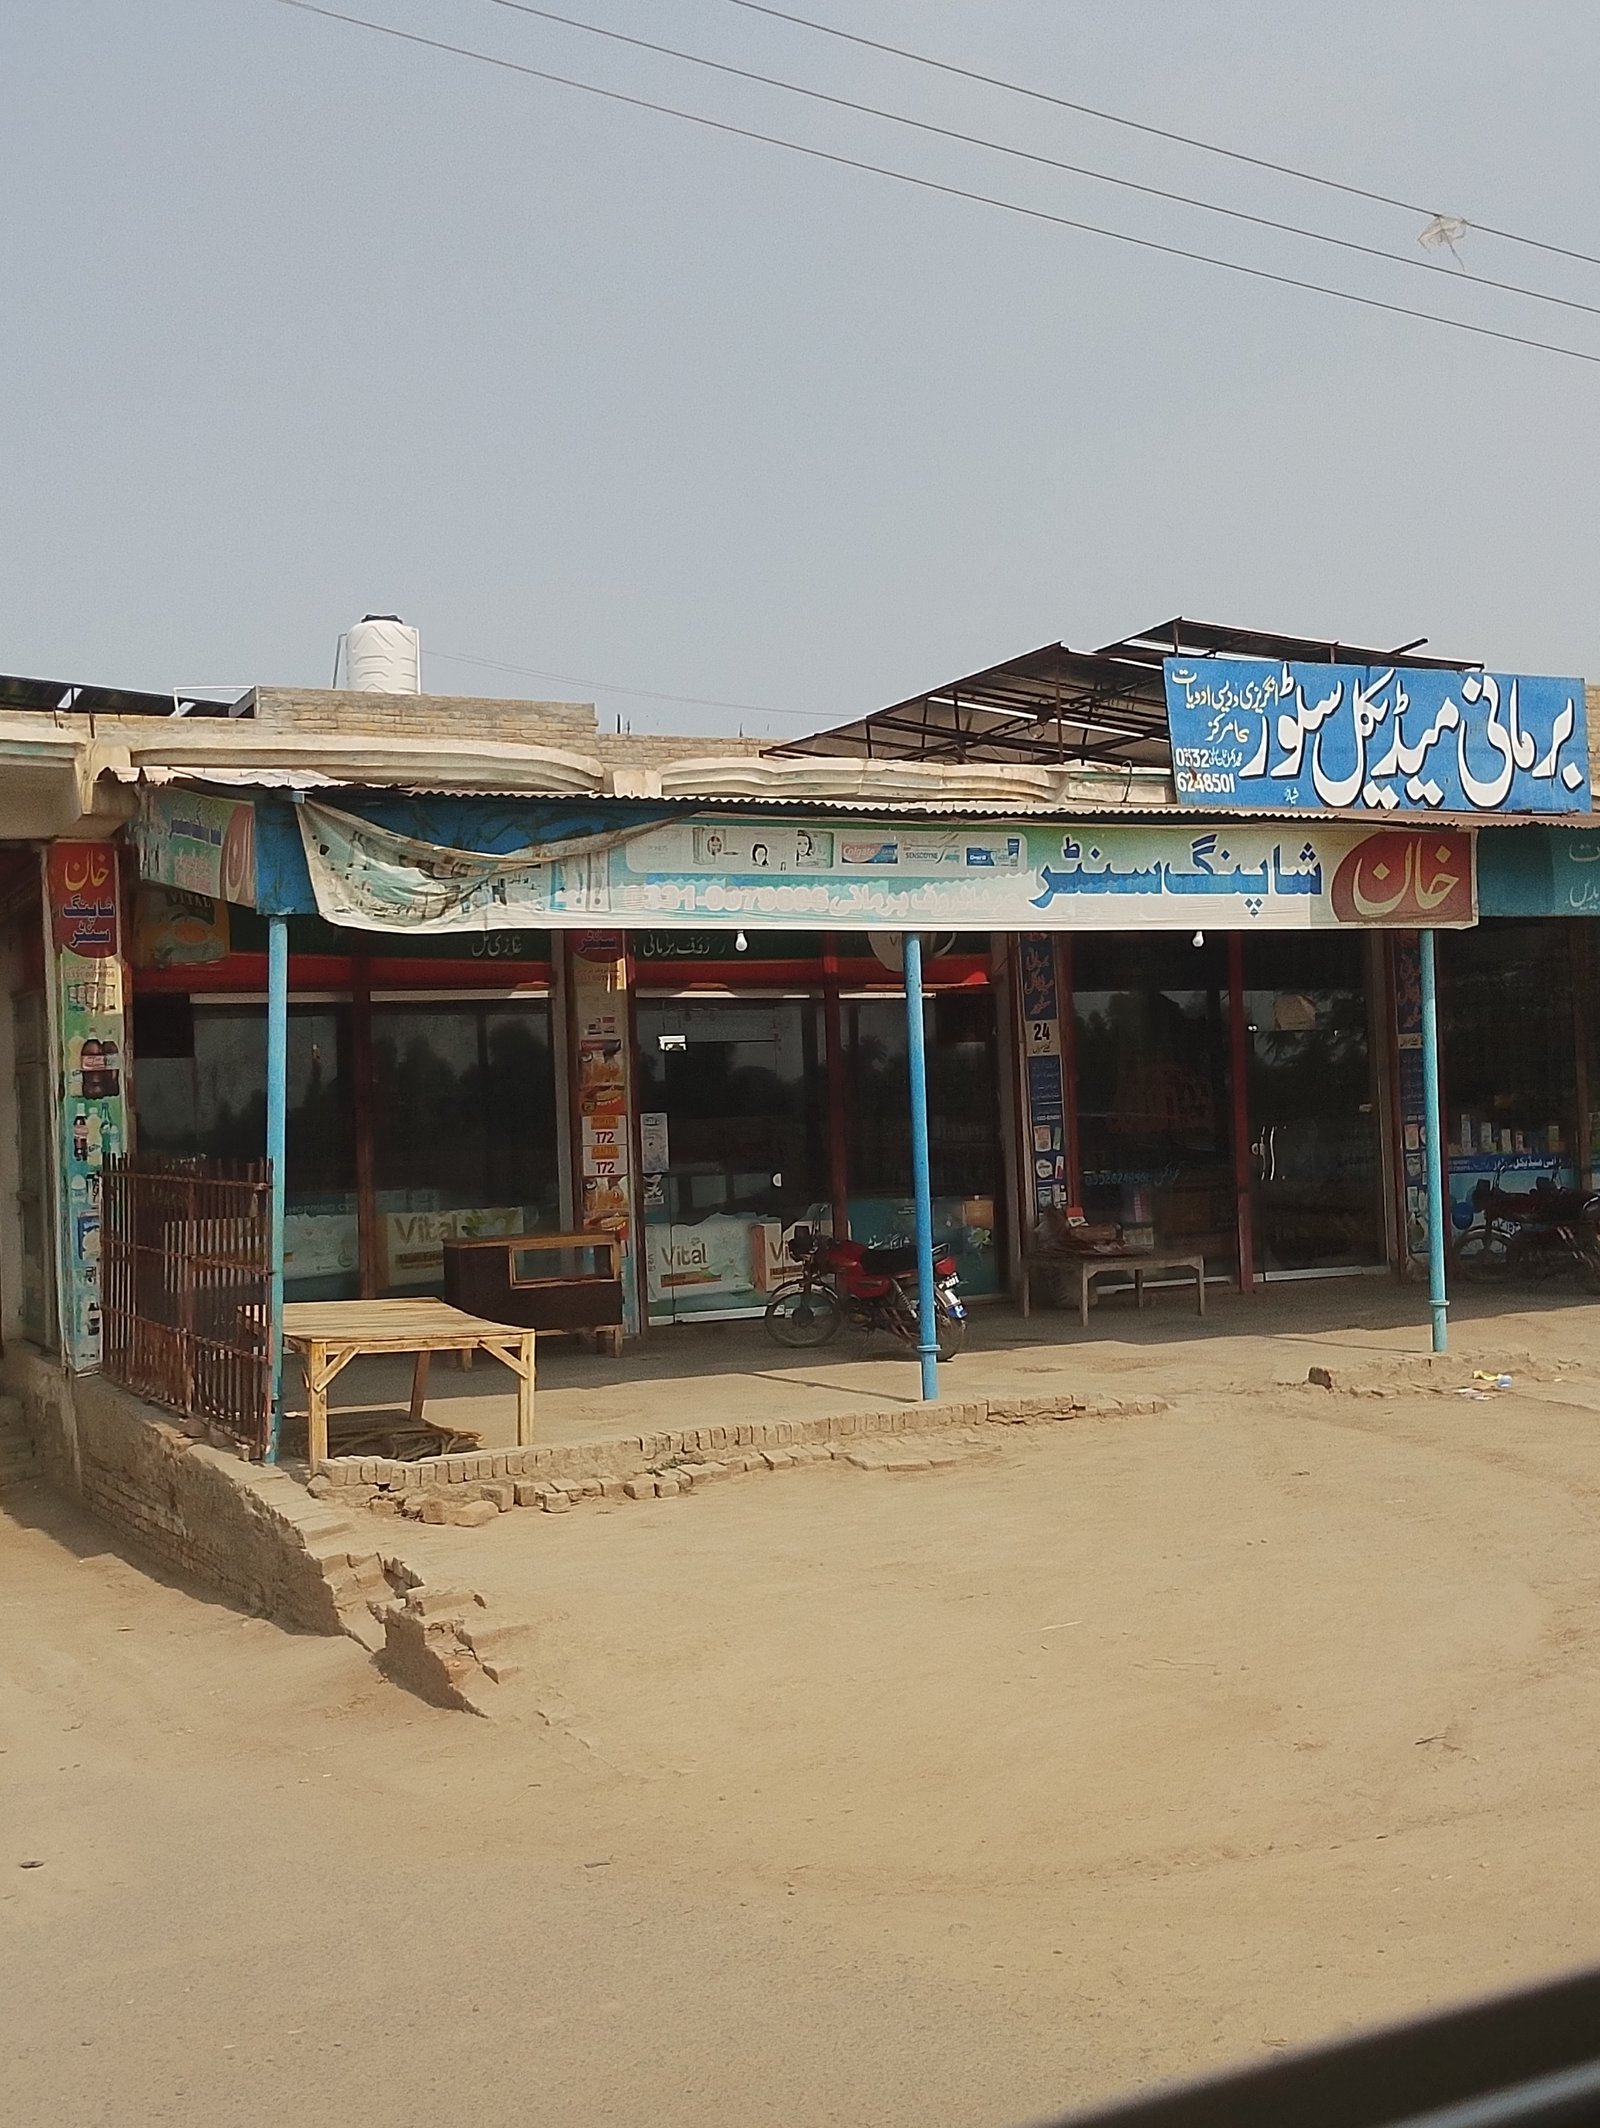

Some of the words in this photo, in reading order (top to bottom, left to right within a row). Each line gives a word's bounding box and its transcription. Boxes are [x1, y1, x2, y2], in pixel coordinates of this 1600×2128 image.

[1238, 661, 1343, 778] سٹور
[1313, 668, 1460, 809] میڈیکل
[1176, 748, 1209, 768] 0332
[1177, 772, 1235, 793] 6248501
[843, 845, 876, 857] Colgate
[64, 849, 111, 891] خان
[1027, 833, 1163, 908] سنٹر
[1163, 832, 1323, 918] شاپنگ
[1352, 838, 1461, 917] خان
[63, 893, 115, 924] شاپنگ
[69, 920, 111, 948] سنٹر
[1034, 1023, 1051, 1041] 24
[595, 1131, 615, 1144] 172
[596, 1161, 615, 1174] 172
[394, 1213, 458, 1246] Vital
[661, 1242, 707, 1267] Vital
